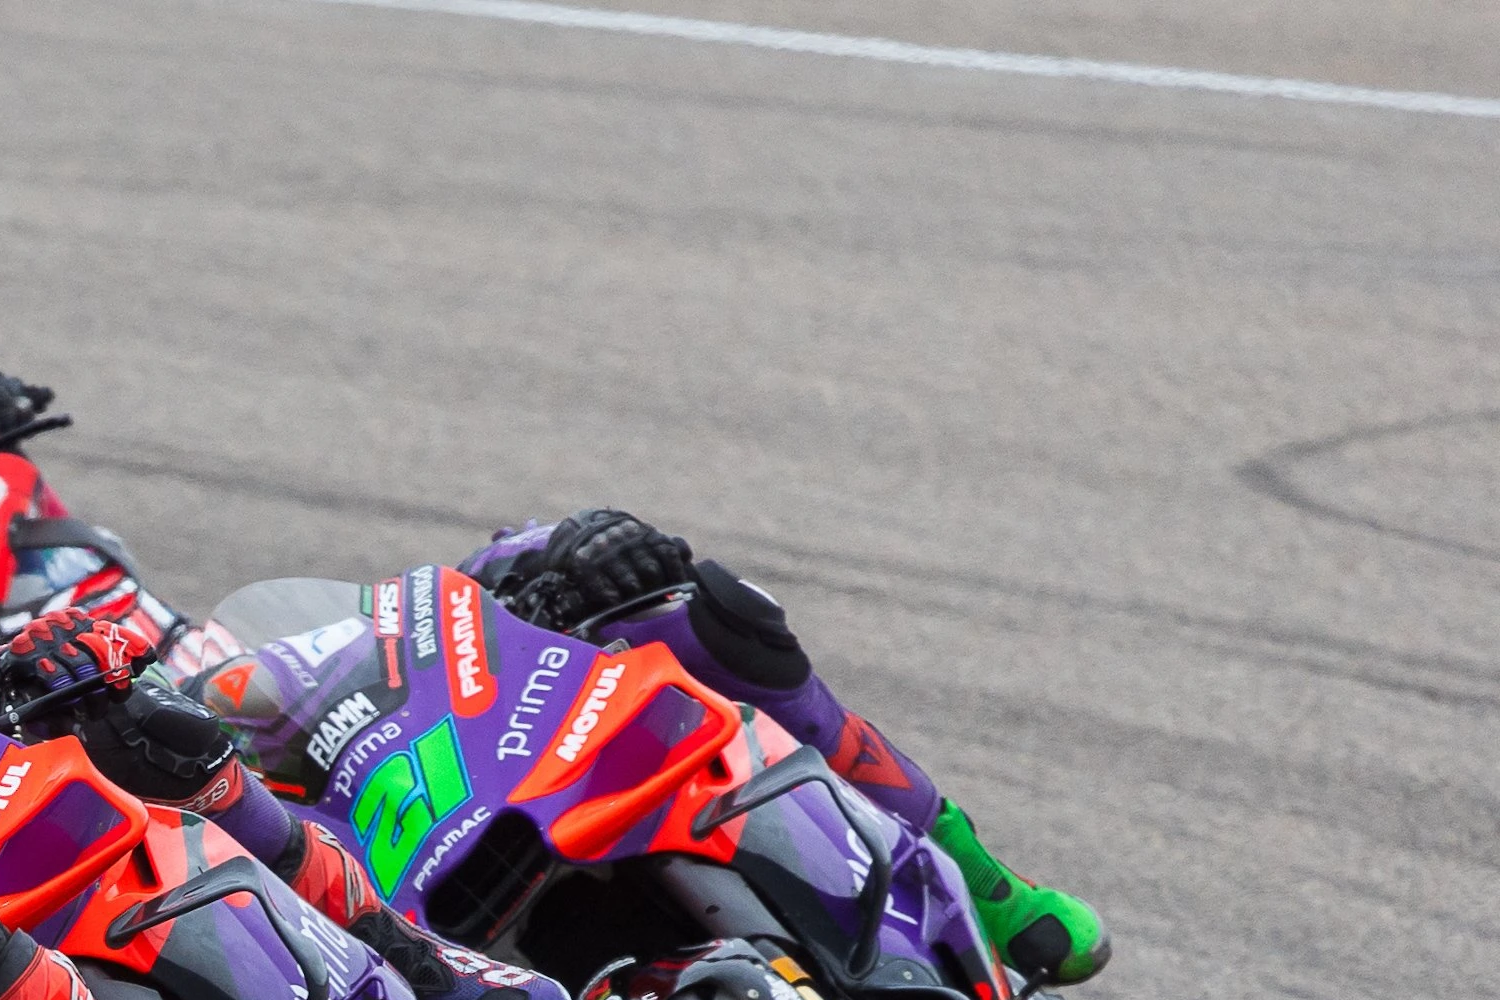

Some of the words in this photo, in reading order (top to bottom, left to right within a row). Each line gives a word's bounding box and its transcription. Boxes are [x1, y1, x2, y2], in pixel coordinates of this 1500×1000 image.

[450, 585, 484, 699] PRAMAC
[306, 691, 378, 770] FIAMM
[496, 645, 571, 761] prima
[556, 663, 626, 763] MOTUL
[335, 720, 402, 798] prima
[352, 714, 474, 905] 21
[414, 806, 492, 891] PRAMAC
